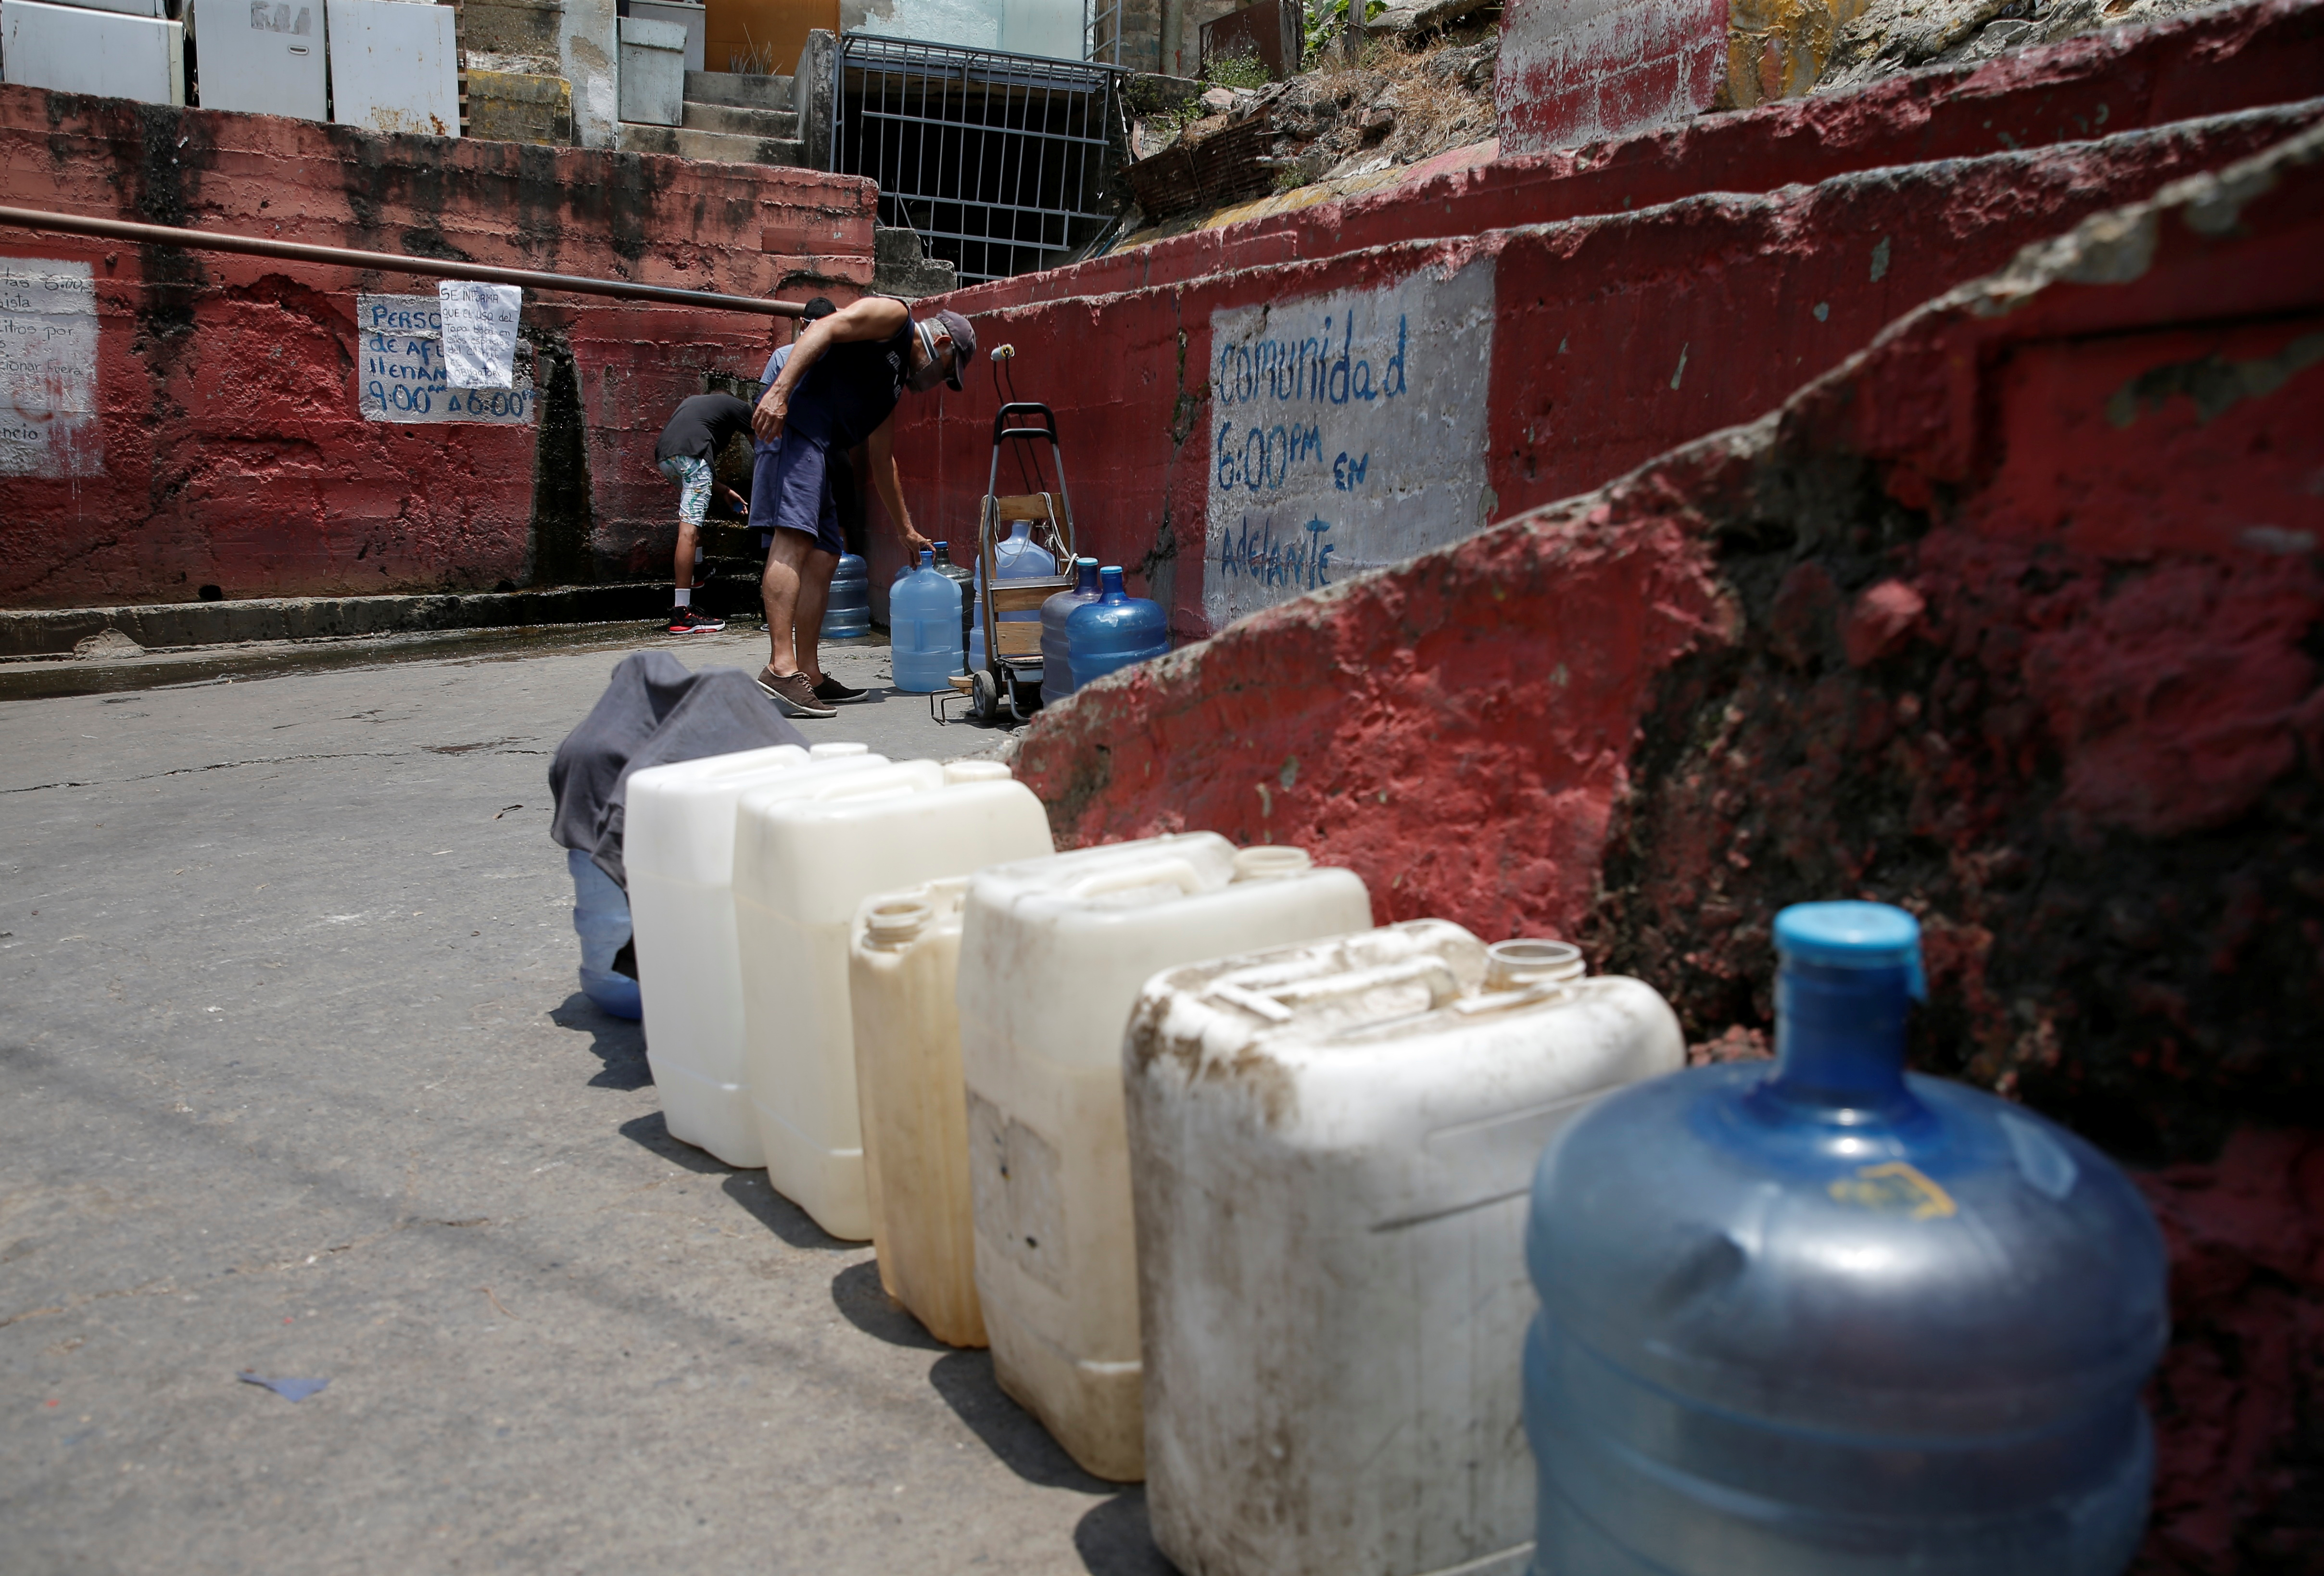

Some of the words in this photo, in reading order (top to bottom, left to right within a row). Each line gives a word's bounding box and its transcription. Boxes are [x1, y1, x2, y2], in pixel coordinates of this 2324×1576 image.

[439, 288, 458, 301] SE
[442, 308, 460, 321] QUE
[498, 310, 514, 322] del
[43, 326, 74, 340] por
[448, 344, 461, 354] del
[1333, 451, 1369, 492] EN
